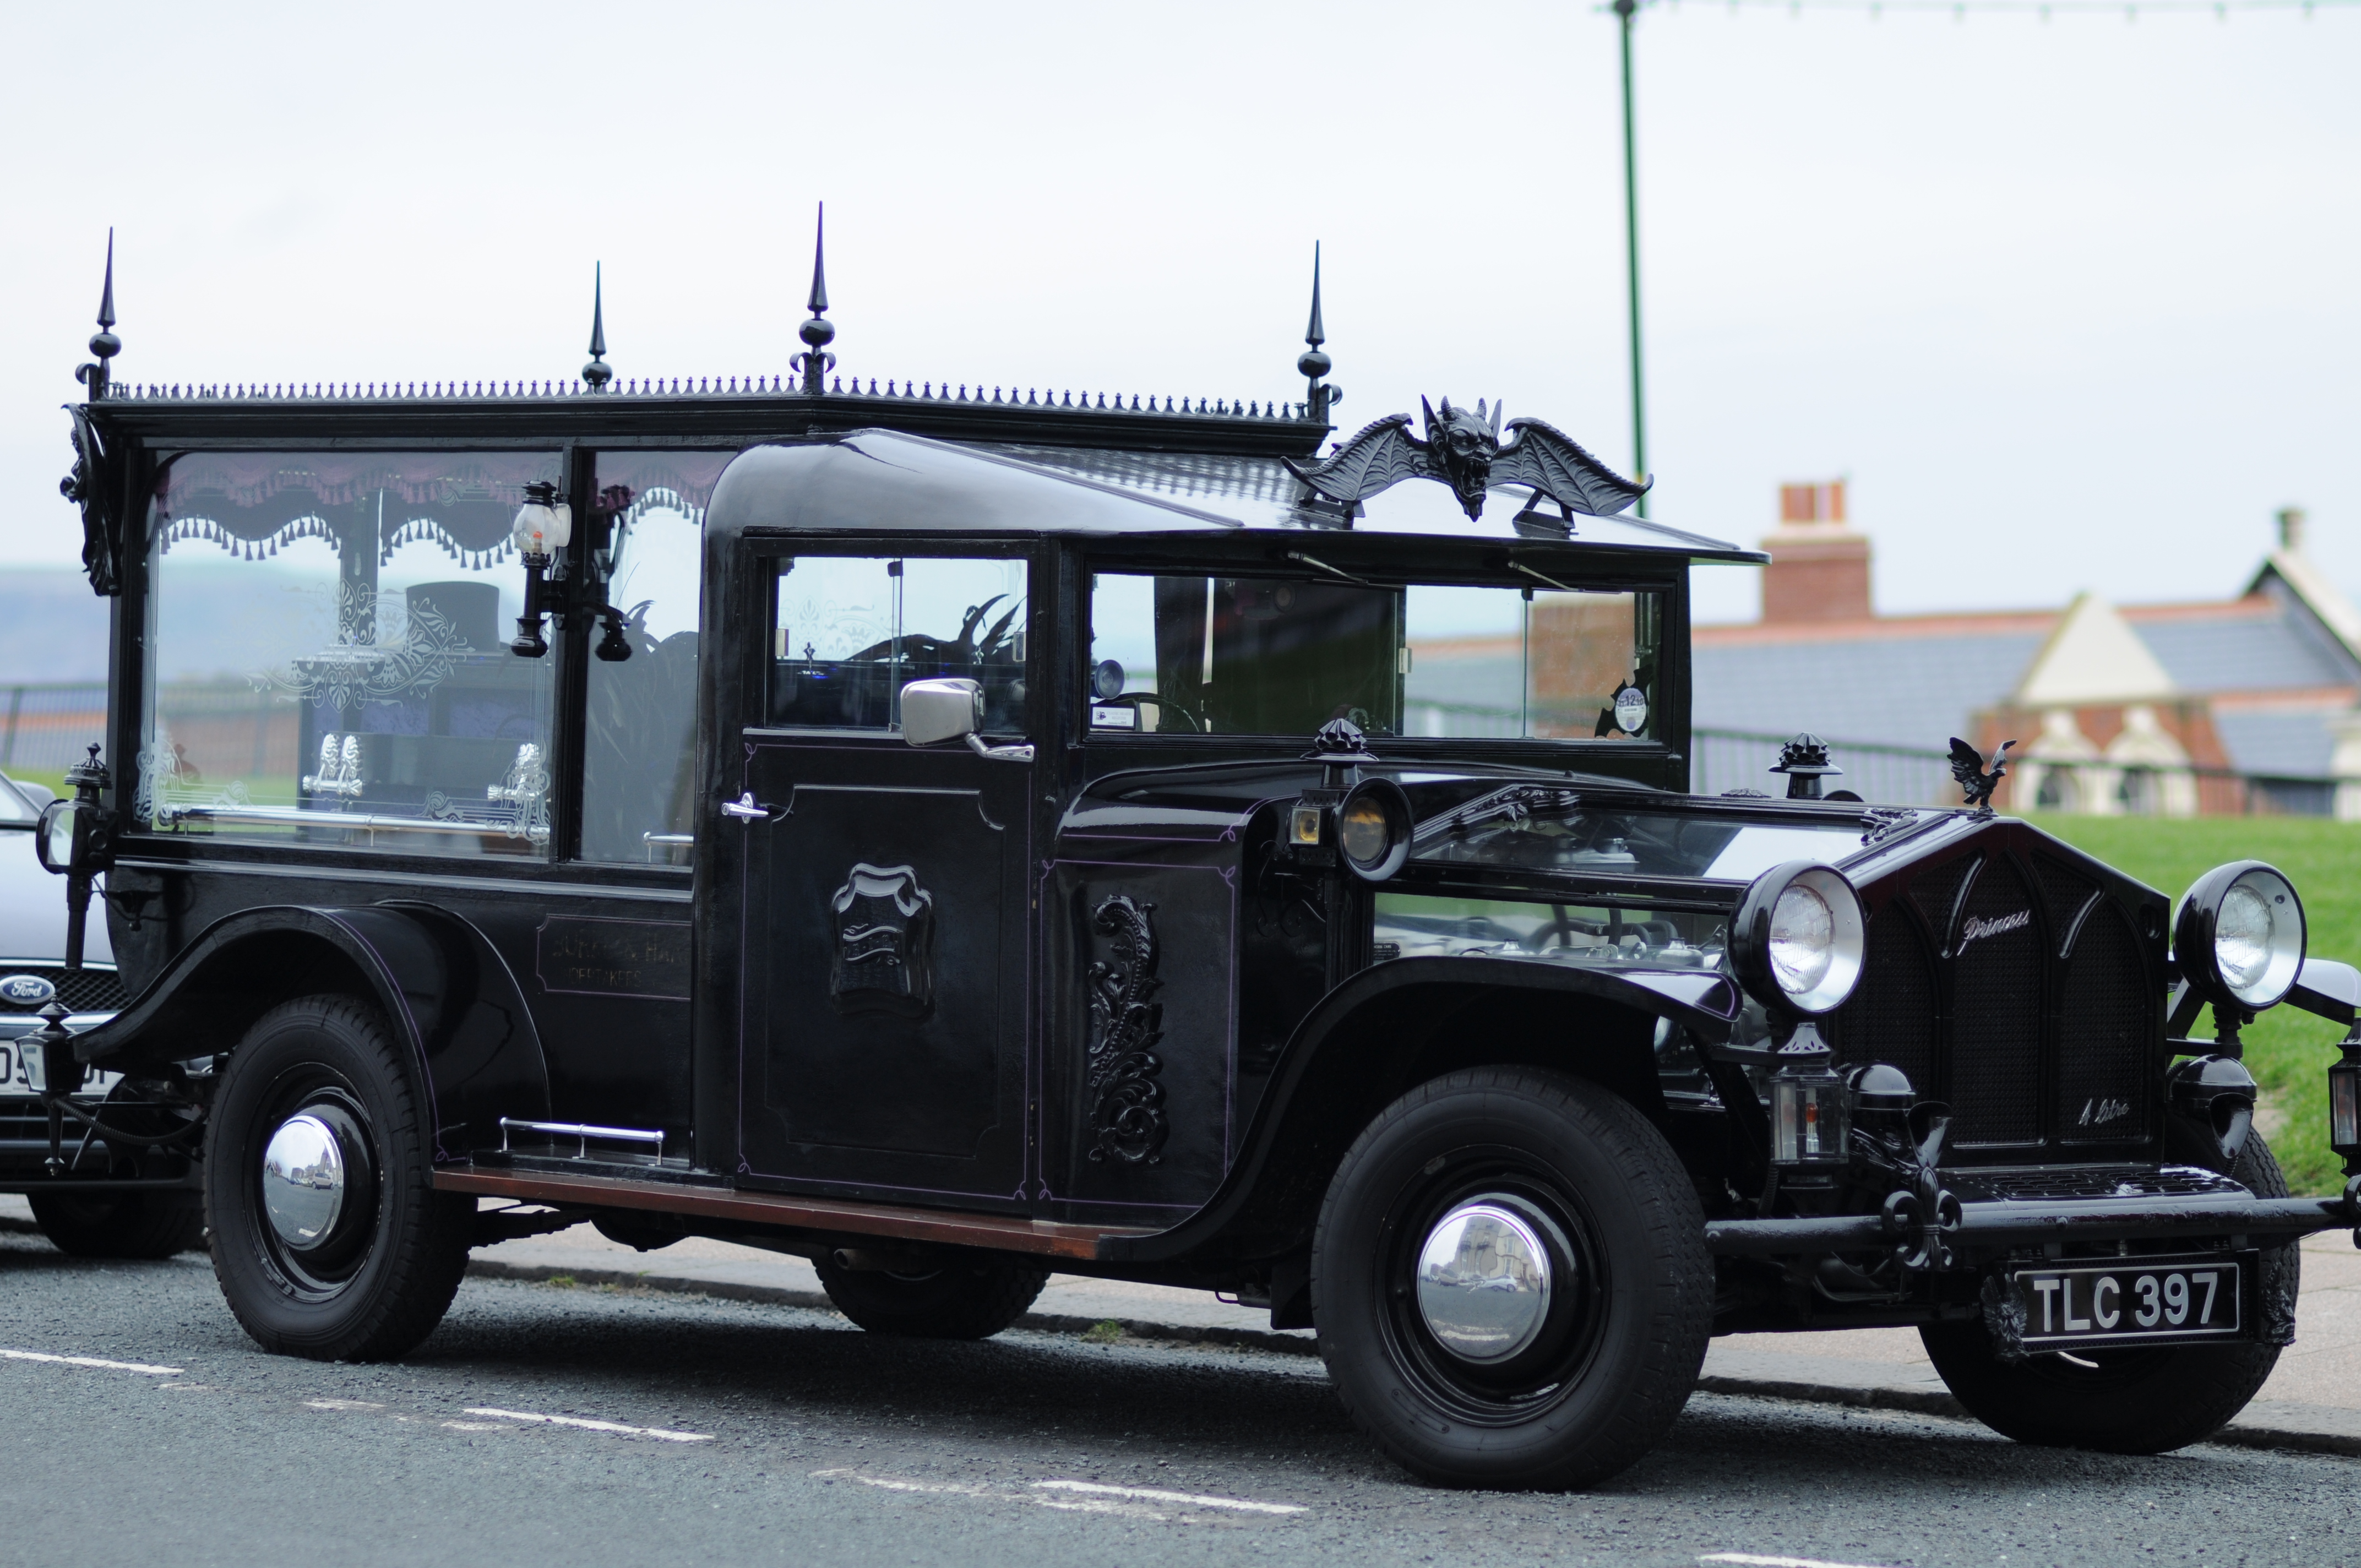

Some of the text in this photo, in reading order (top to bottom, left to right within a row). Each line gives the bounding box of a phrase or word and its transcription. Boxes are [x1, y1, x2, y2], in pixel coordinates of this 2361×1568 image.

[1625, 694, 1636, 706] 12
[1956, 909, 2030, 956] Princess
[11, 981, 43, 997] Ford
[2034, 1272, 2218, 1332] TLC 397
